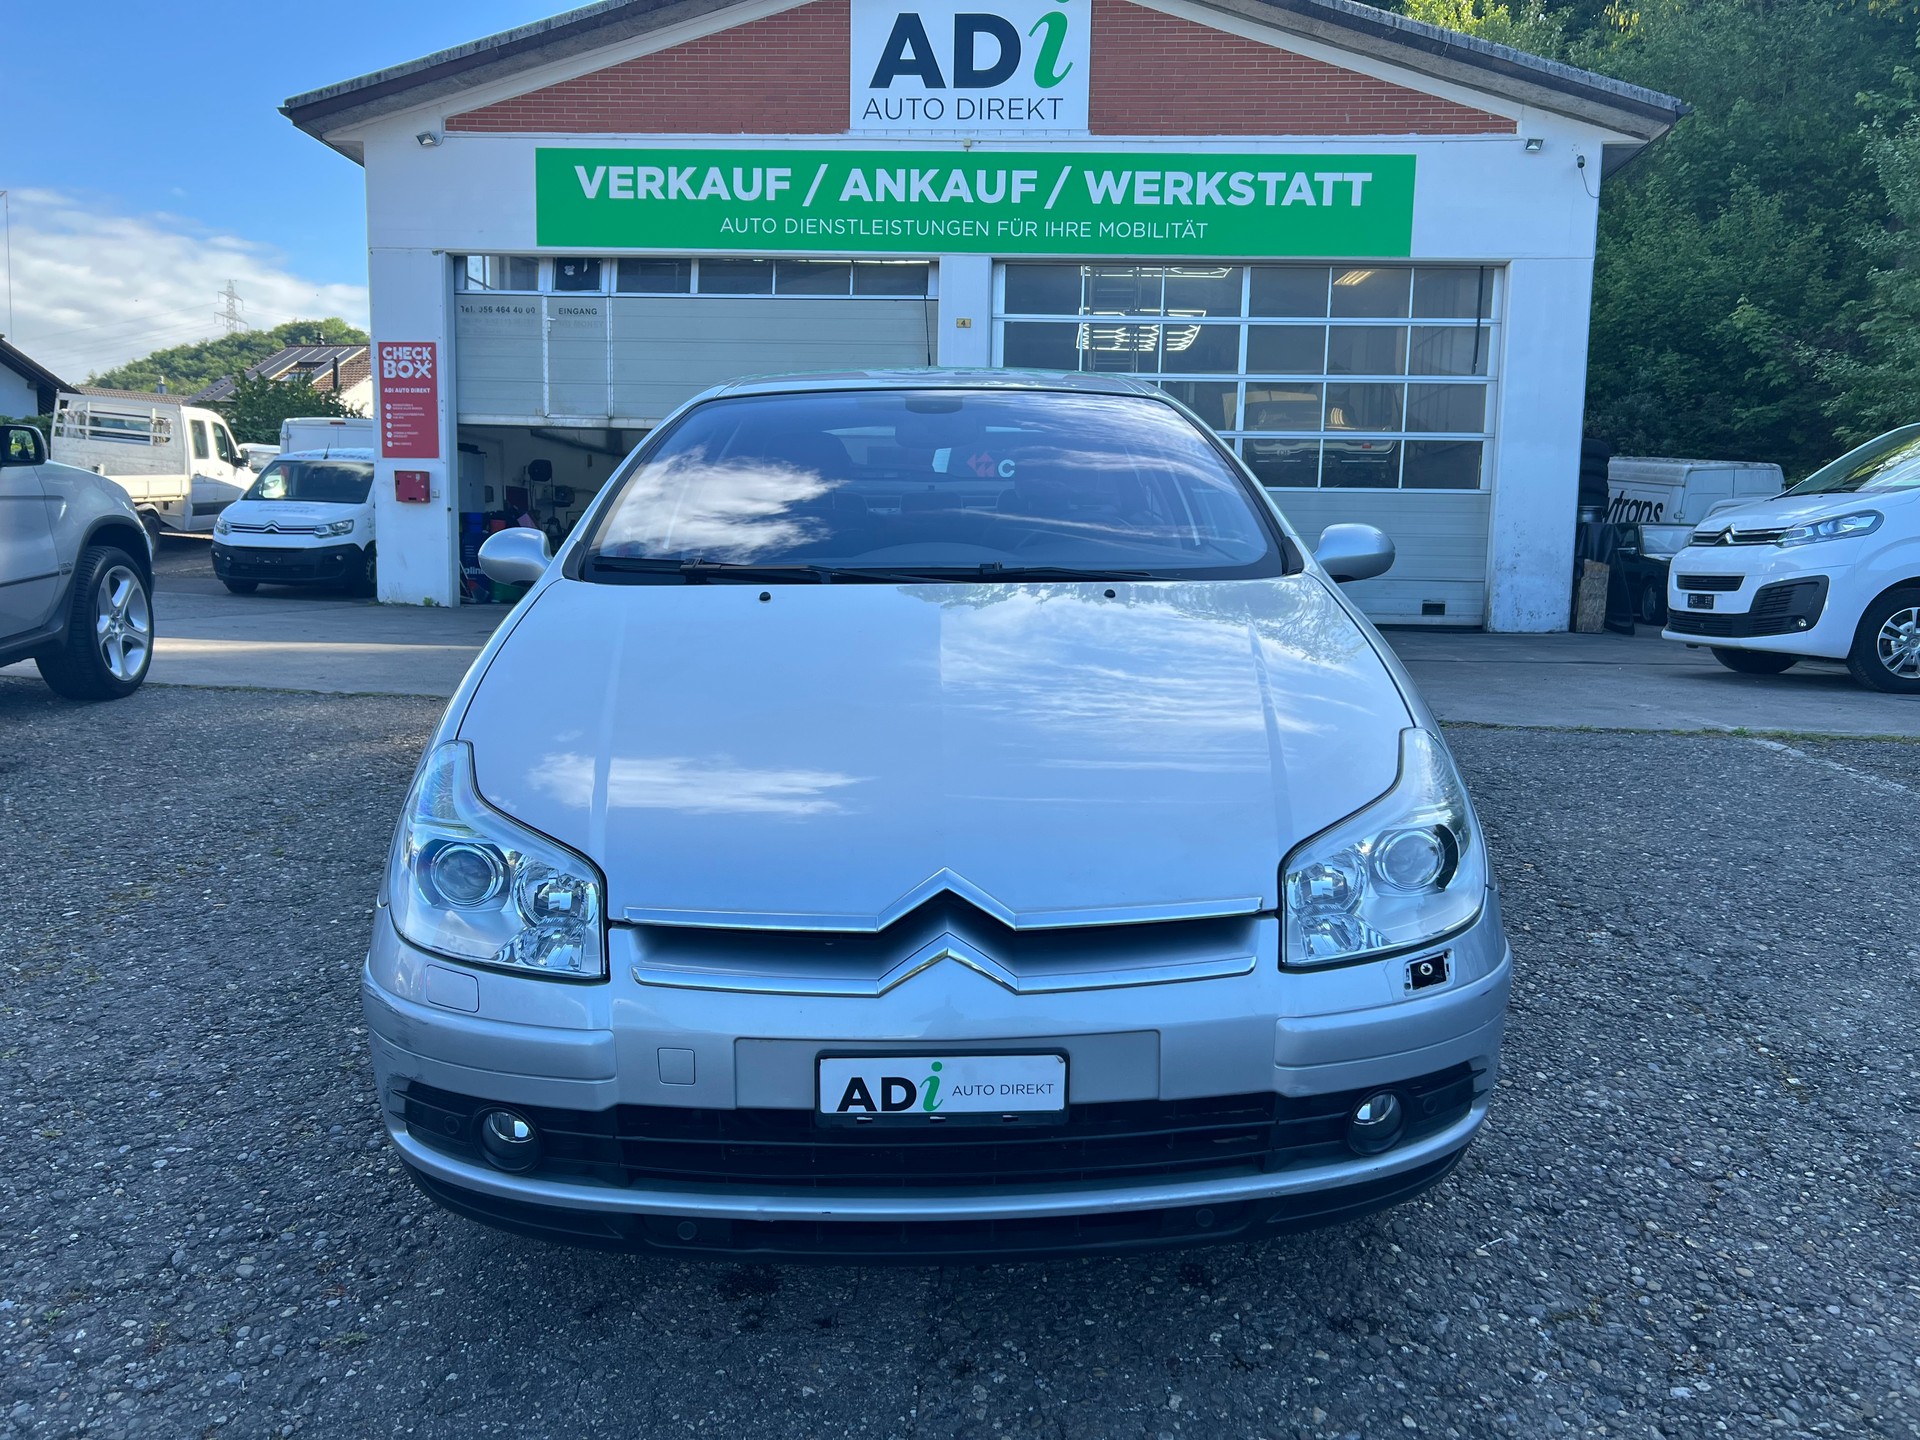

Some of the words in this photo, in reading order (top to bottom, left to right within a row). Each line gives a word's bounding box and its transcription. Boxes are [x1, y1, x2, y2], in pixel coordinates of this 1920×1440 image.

[868, 0, 1074, 89] ADi
[862, 97, 945, 120] AUTO
[956, 97, 1064, 120] DIREKT
[574, 165, 792, 202] VERKAUF
[802, 163, 829, 207] /
[838, 168, 1038, 204] ANKAUF
[1044, 165, 1073, 210] /
[1083, 170, 1373, 207] WERKSTATT
[719, 217, 777, 234] AUTO
[784, 218, 990, 237] DIENSTLEISTUNGEN
[997, 218, 1038, 237] FÜR
[1044, 221, 1093, 238] IHRE
[1098, 219, 1209, 239] MOBILITÄT
[558, 307, 598, 316] EINGANG
[382, 346, 432, 360] CHECK
[383, 360, 432, 379] BOX
[836, 1061, 944, 1112] ADi
[952, 1084, 995, 1096] AUTO
[999, 1083, 1055, 1096] DIREKT
